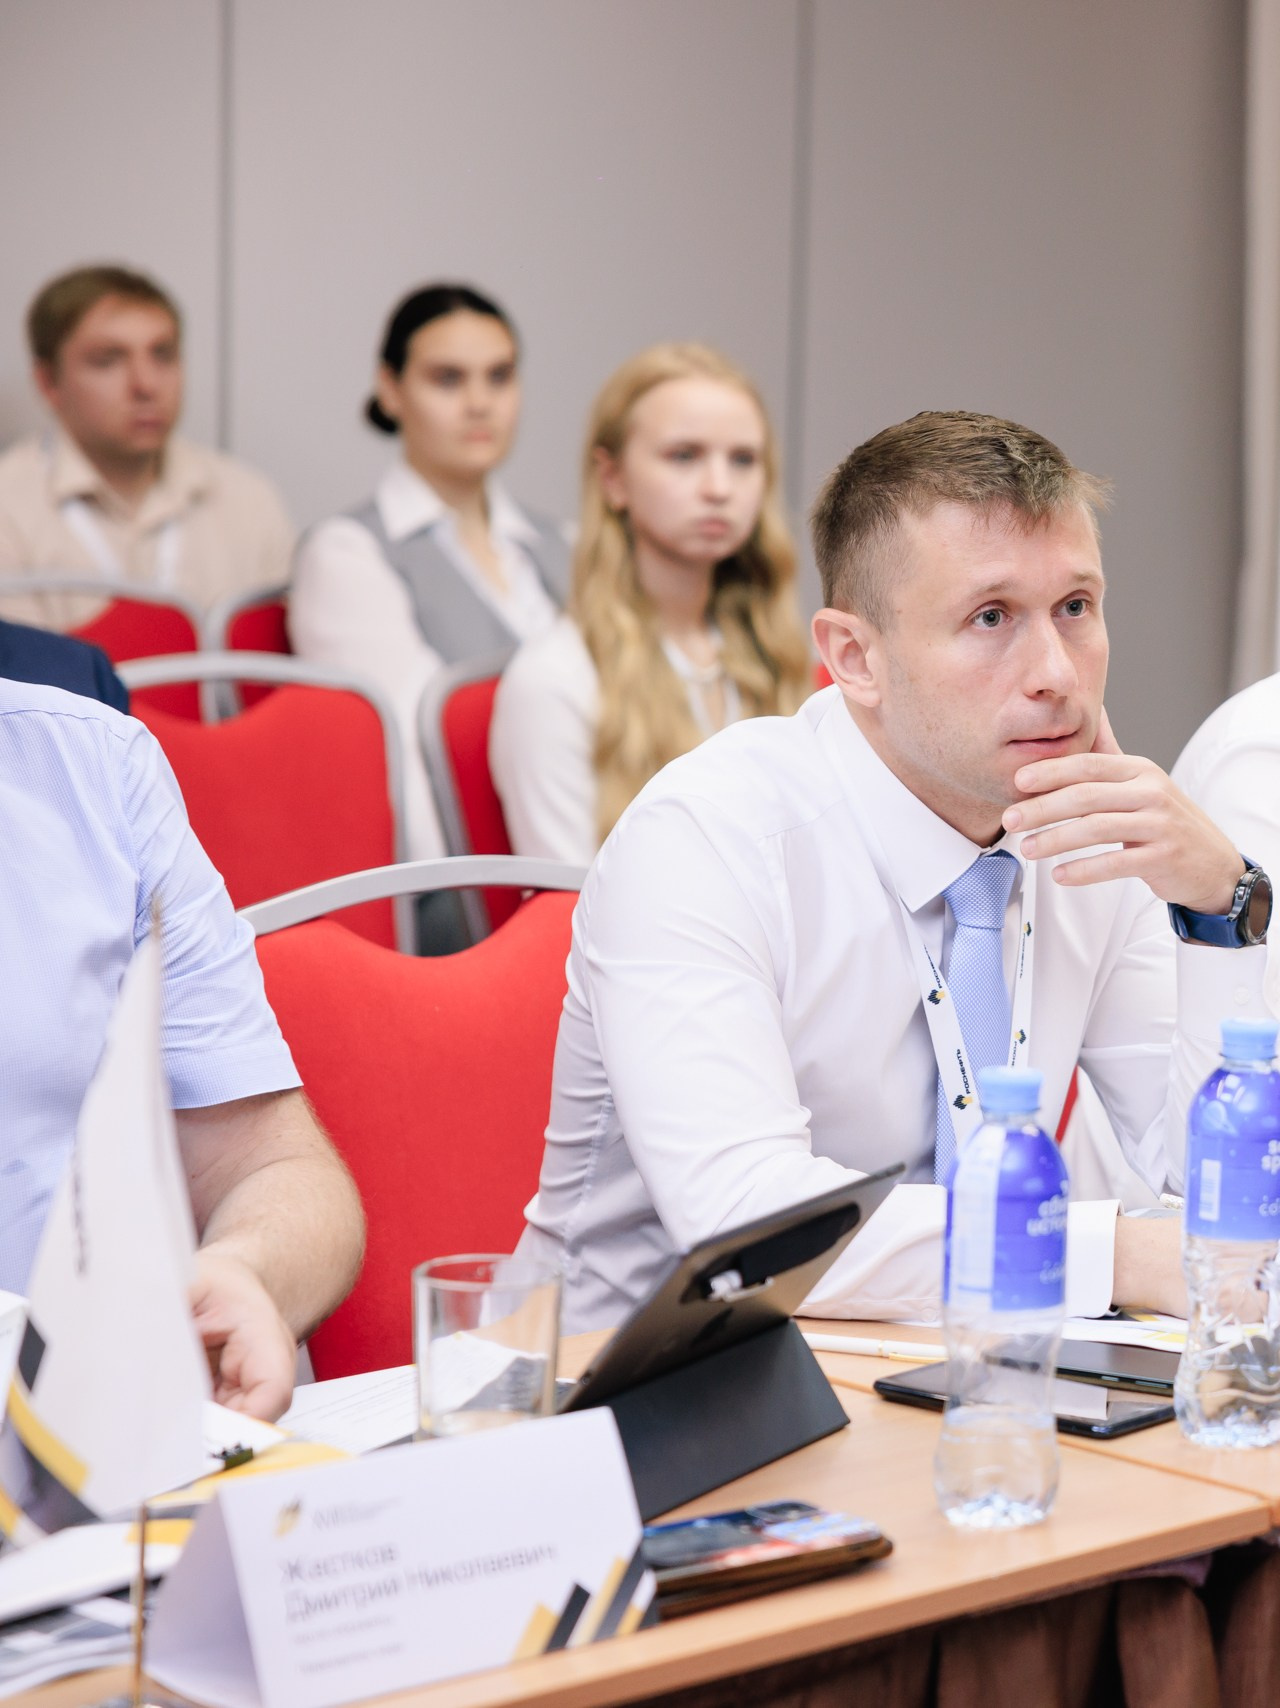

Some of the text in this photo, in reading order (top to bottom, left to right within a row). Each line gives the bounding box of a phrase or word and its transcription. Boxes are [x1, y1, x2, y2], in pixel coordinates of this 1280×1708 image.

[956, 1048, 971, 1095] РОСНЕФТЬ
[285, 1545, 557, 1624] Дмитрий Николаевич
